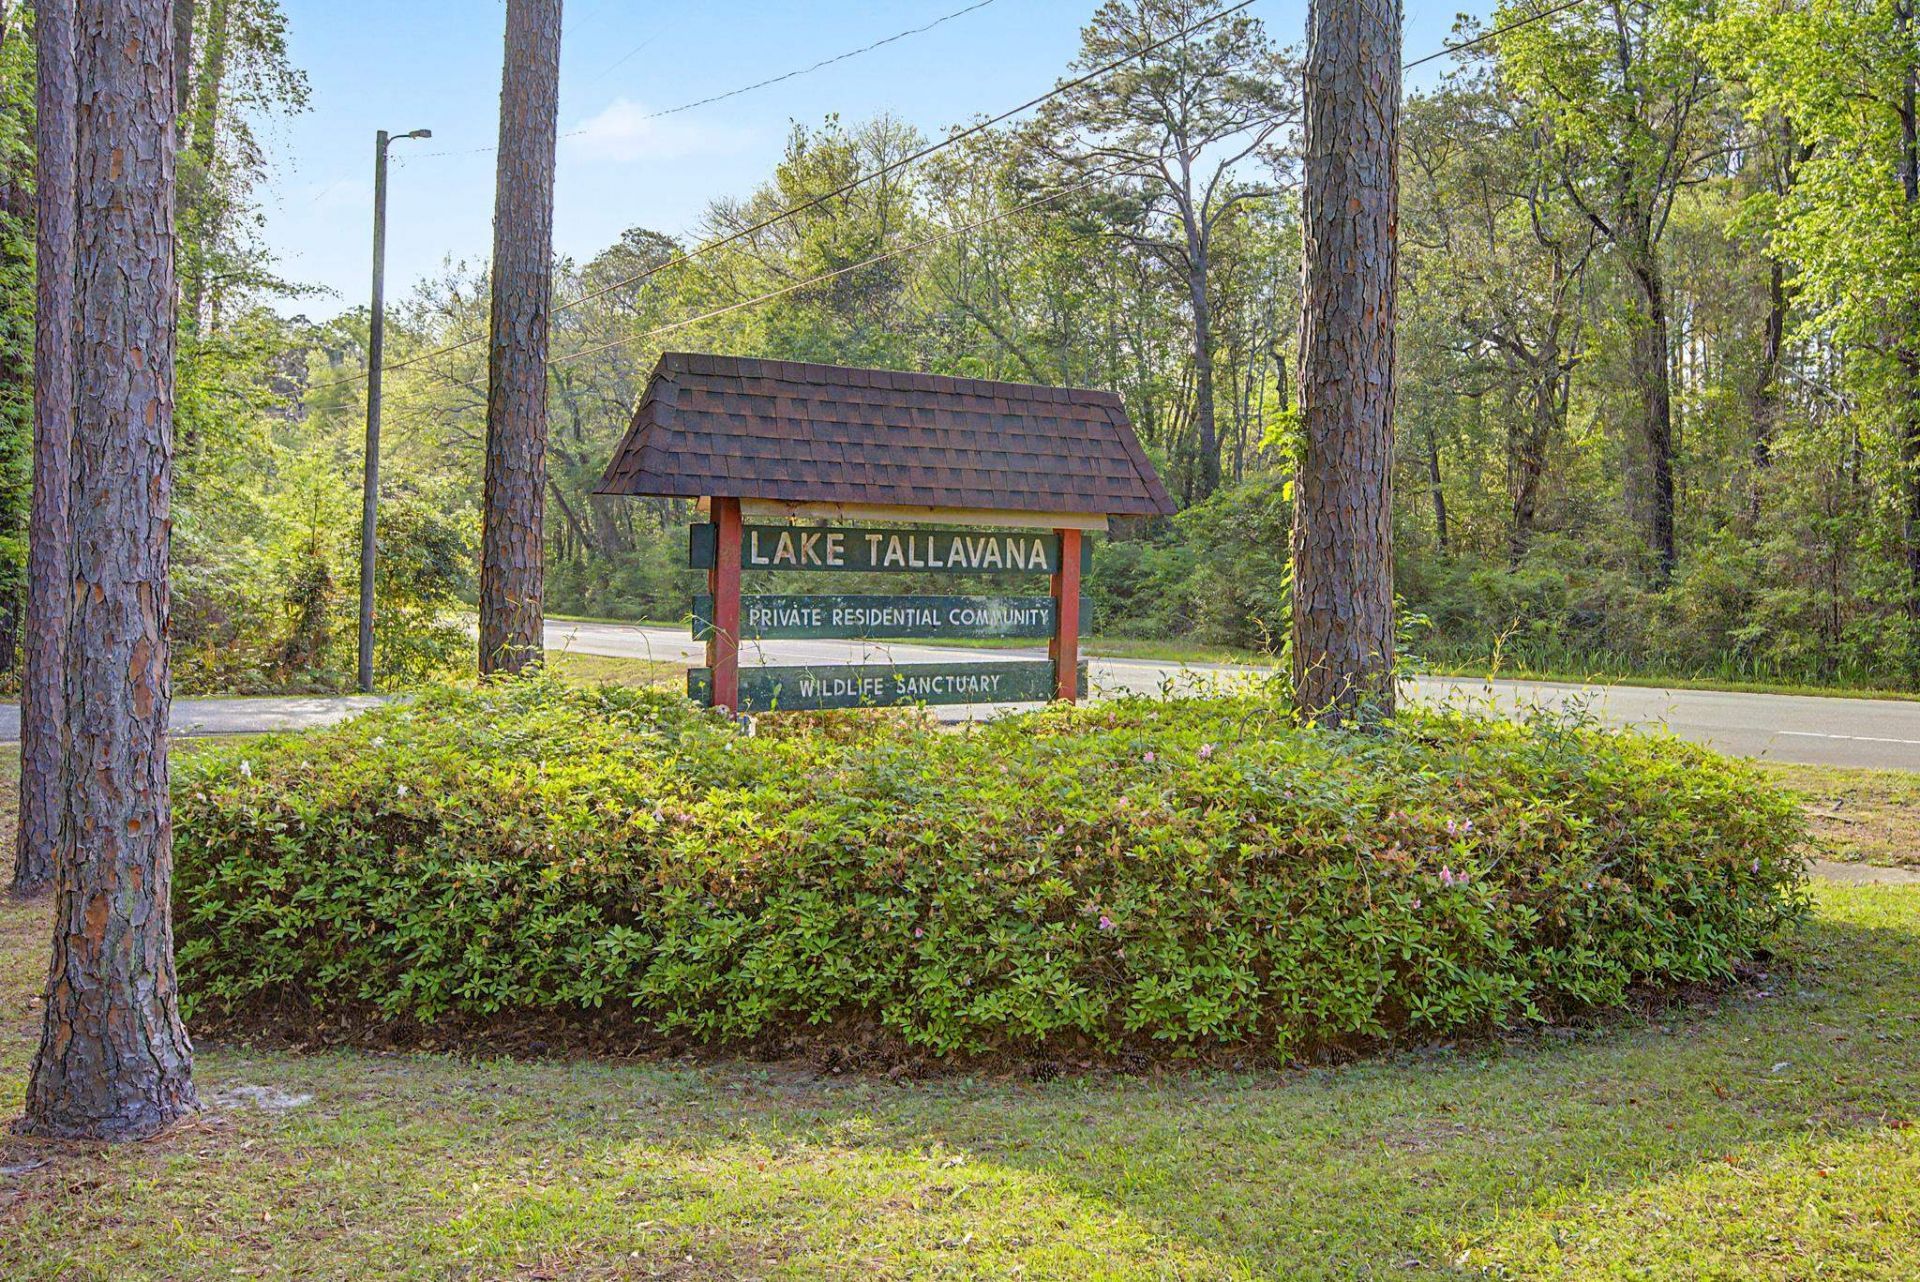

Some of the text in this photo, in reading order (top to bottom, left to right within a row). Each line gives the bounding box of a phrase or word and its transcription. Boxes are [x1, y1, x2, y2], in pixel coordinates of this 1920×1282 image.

[751, 531, 1048, 570] LAKE TALLAVANA
[749, 607, 1049, 627] PRIVATE RESIDENTIAL COMMUNITY
[800, 675, 1000, 697] WILDLIFE SANCTUARY
